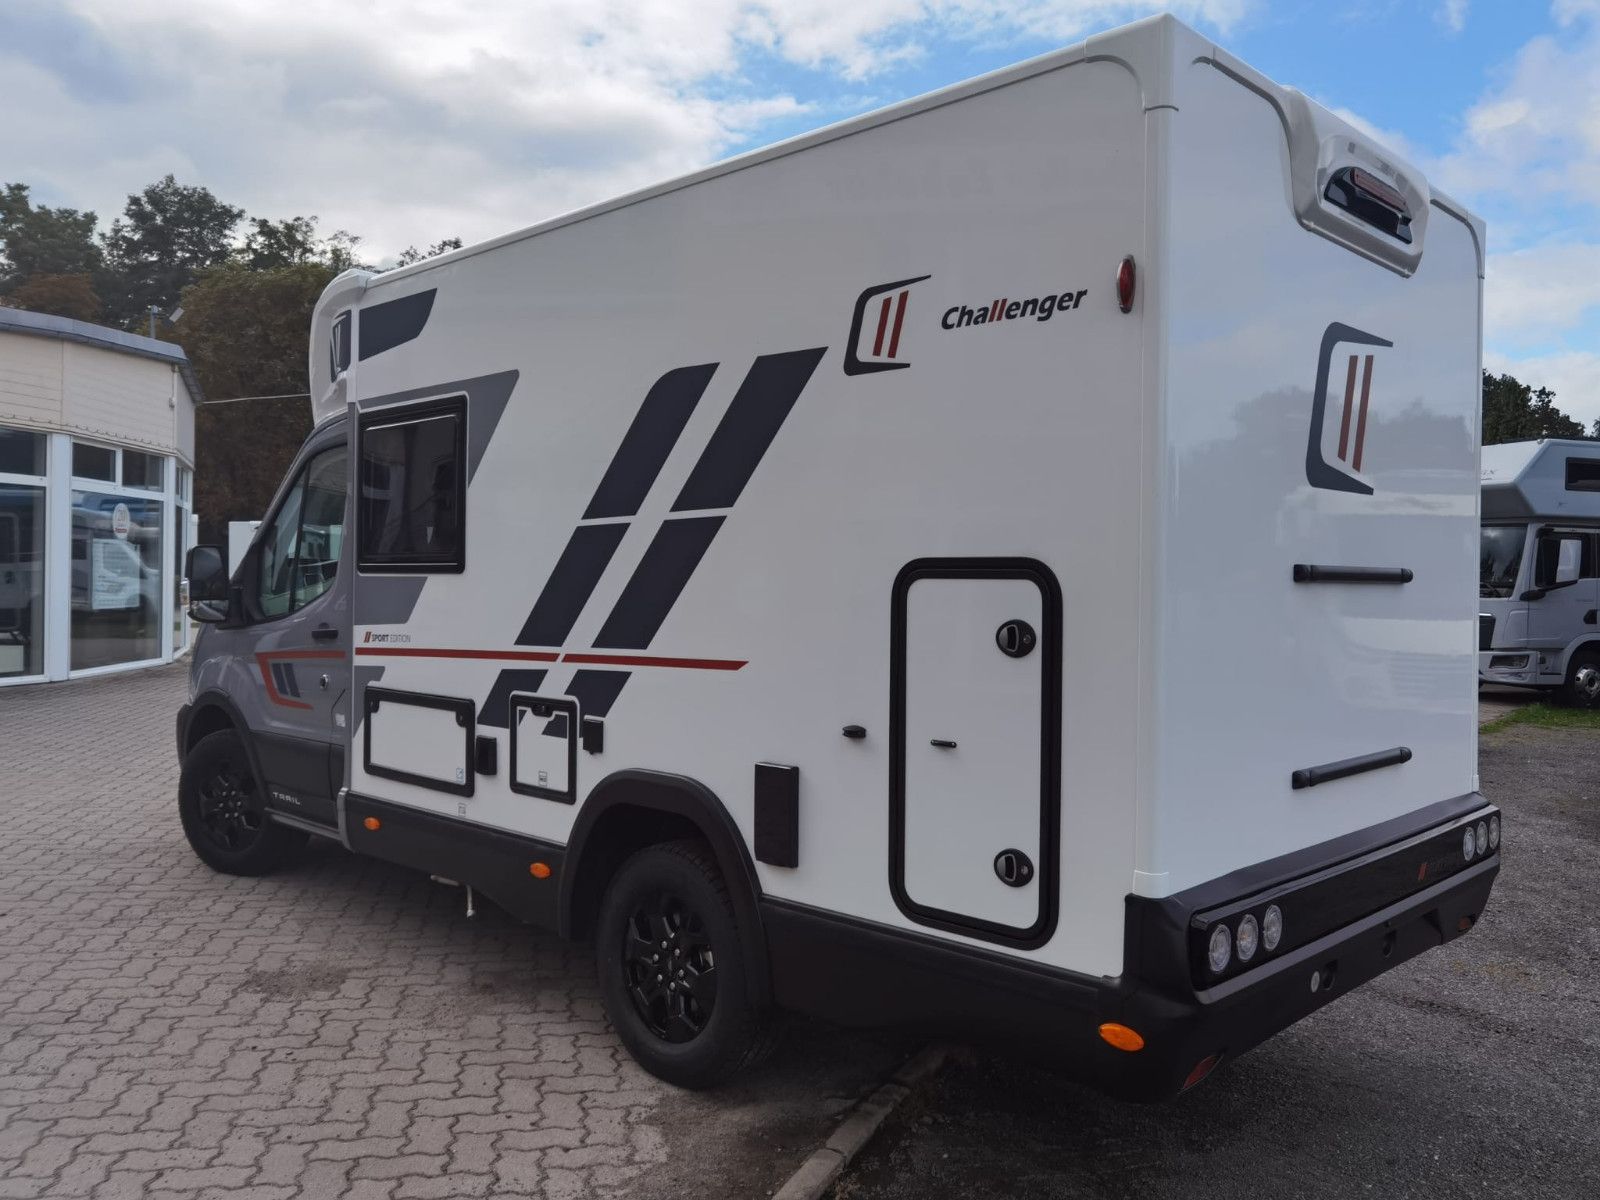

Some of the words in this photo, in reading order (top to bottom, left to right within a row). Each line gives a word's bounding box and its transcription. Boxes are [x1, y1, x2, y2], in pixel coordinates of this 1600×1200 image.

[941, 288, 1088, 330] Challenger
[371, 633, 389, 643] SPORT
[389, 634, 411, 643] EDITION
